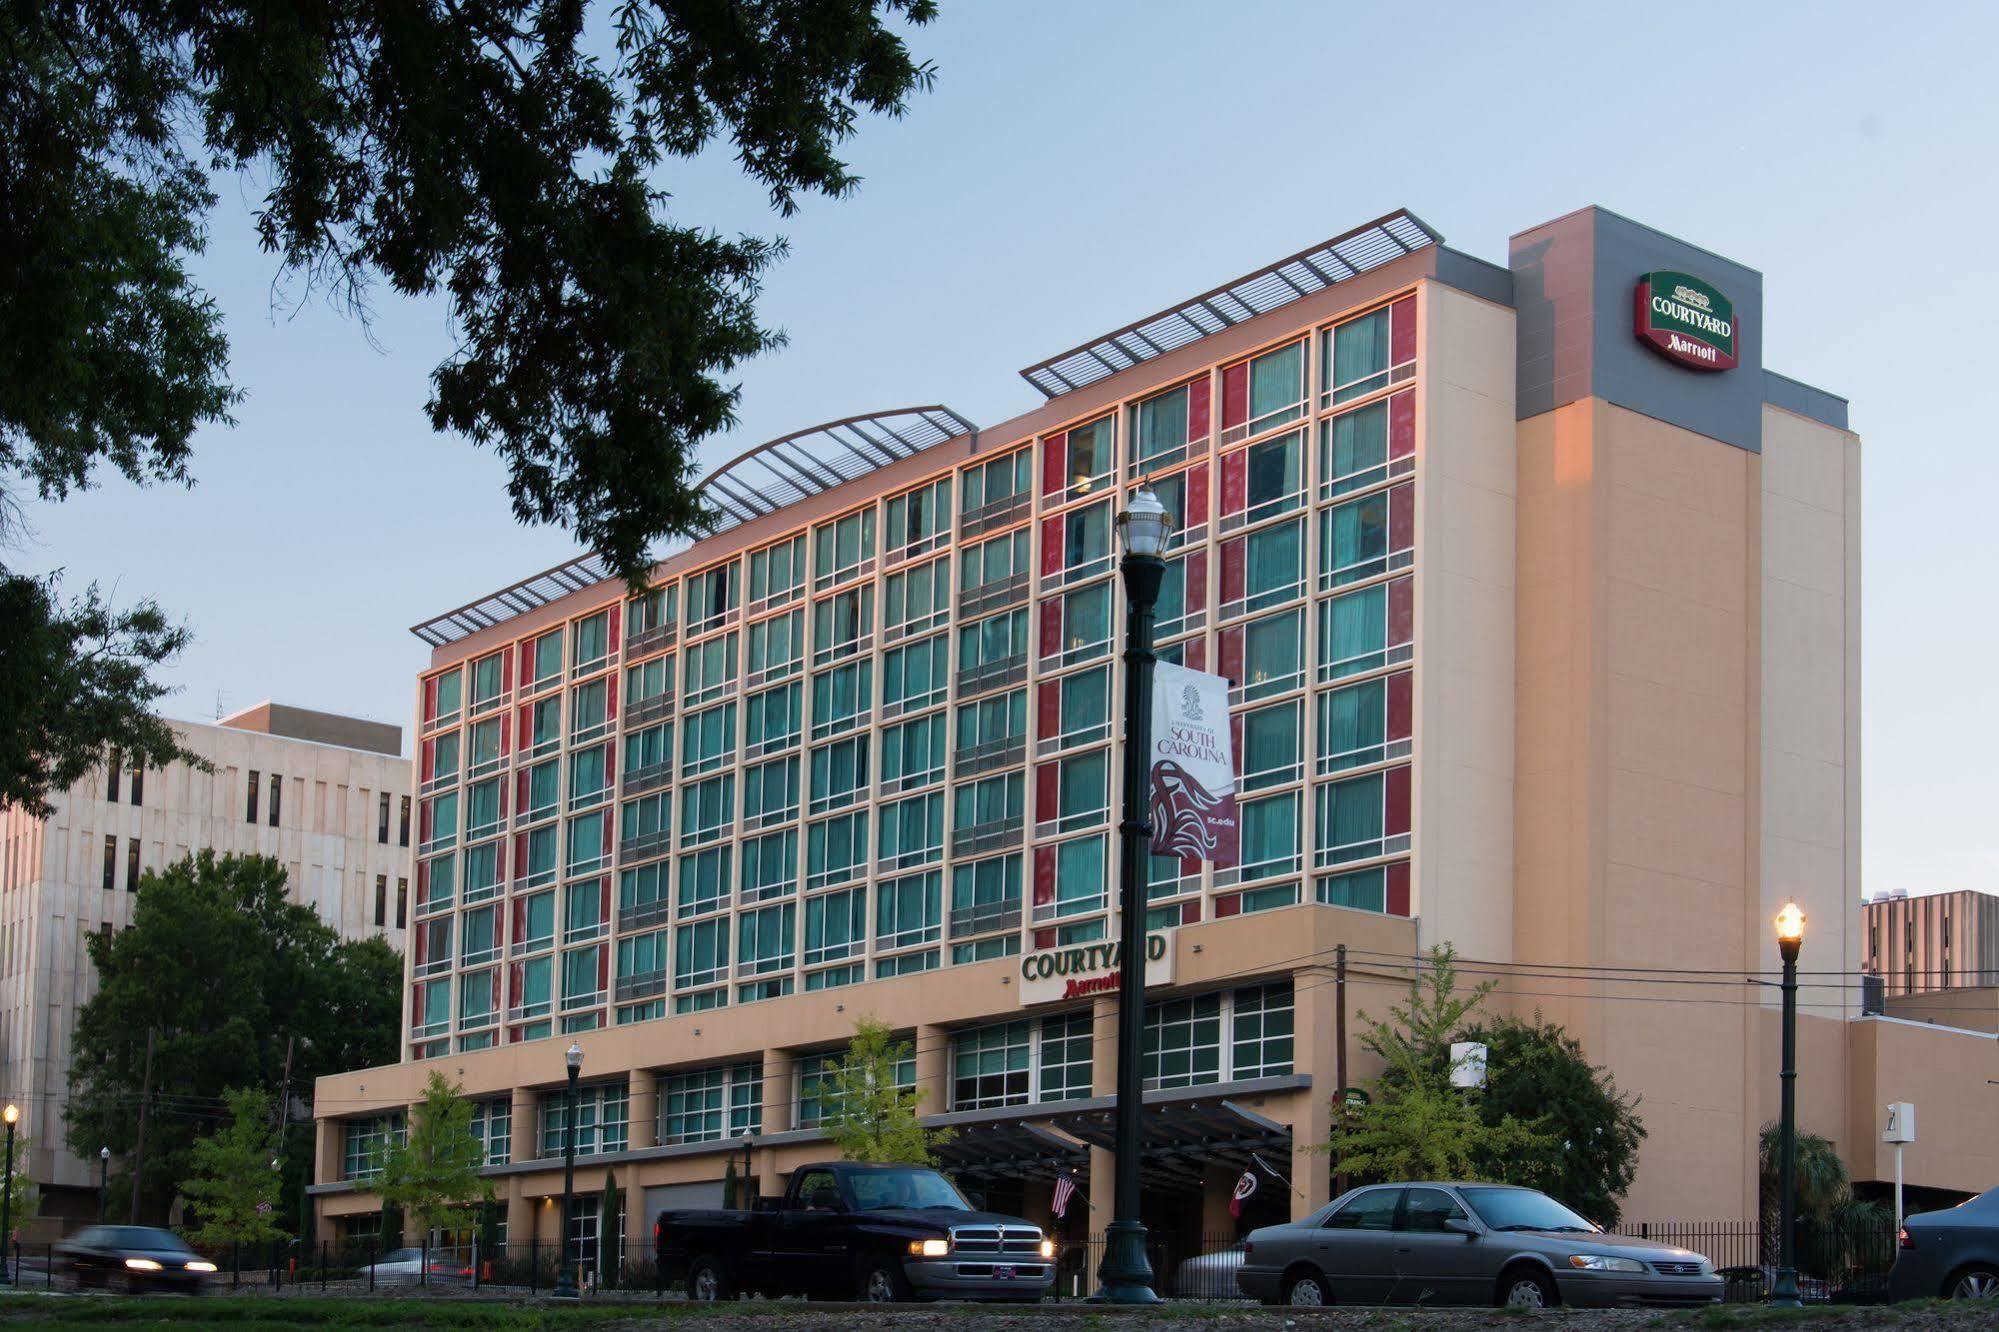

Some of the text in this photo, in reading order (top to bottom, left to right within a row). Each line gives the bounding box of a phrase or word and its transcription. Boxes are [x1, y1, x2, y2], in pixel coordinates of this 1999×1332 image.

[1652, 296, 1731, 337] COURTYARD
[1668, 334, 1716, 362] Marriott
[1171, 727, 1215, 749] SOUTH
[1157, 739, 1226, 766] CAROLINA
[1022, 935, 1166, 982] COURTYD
